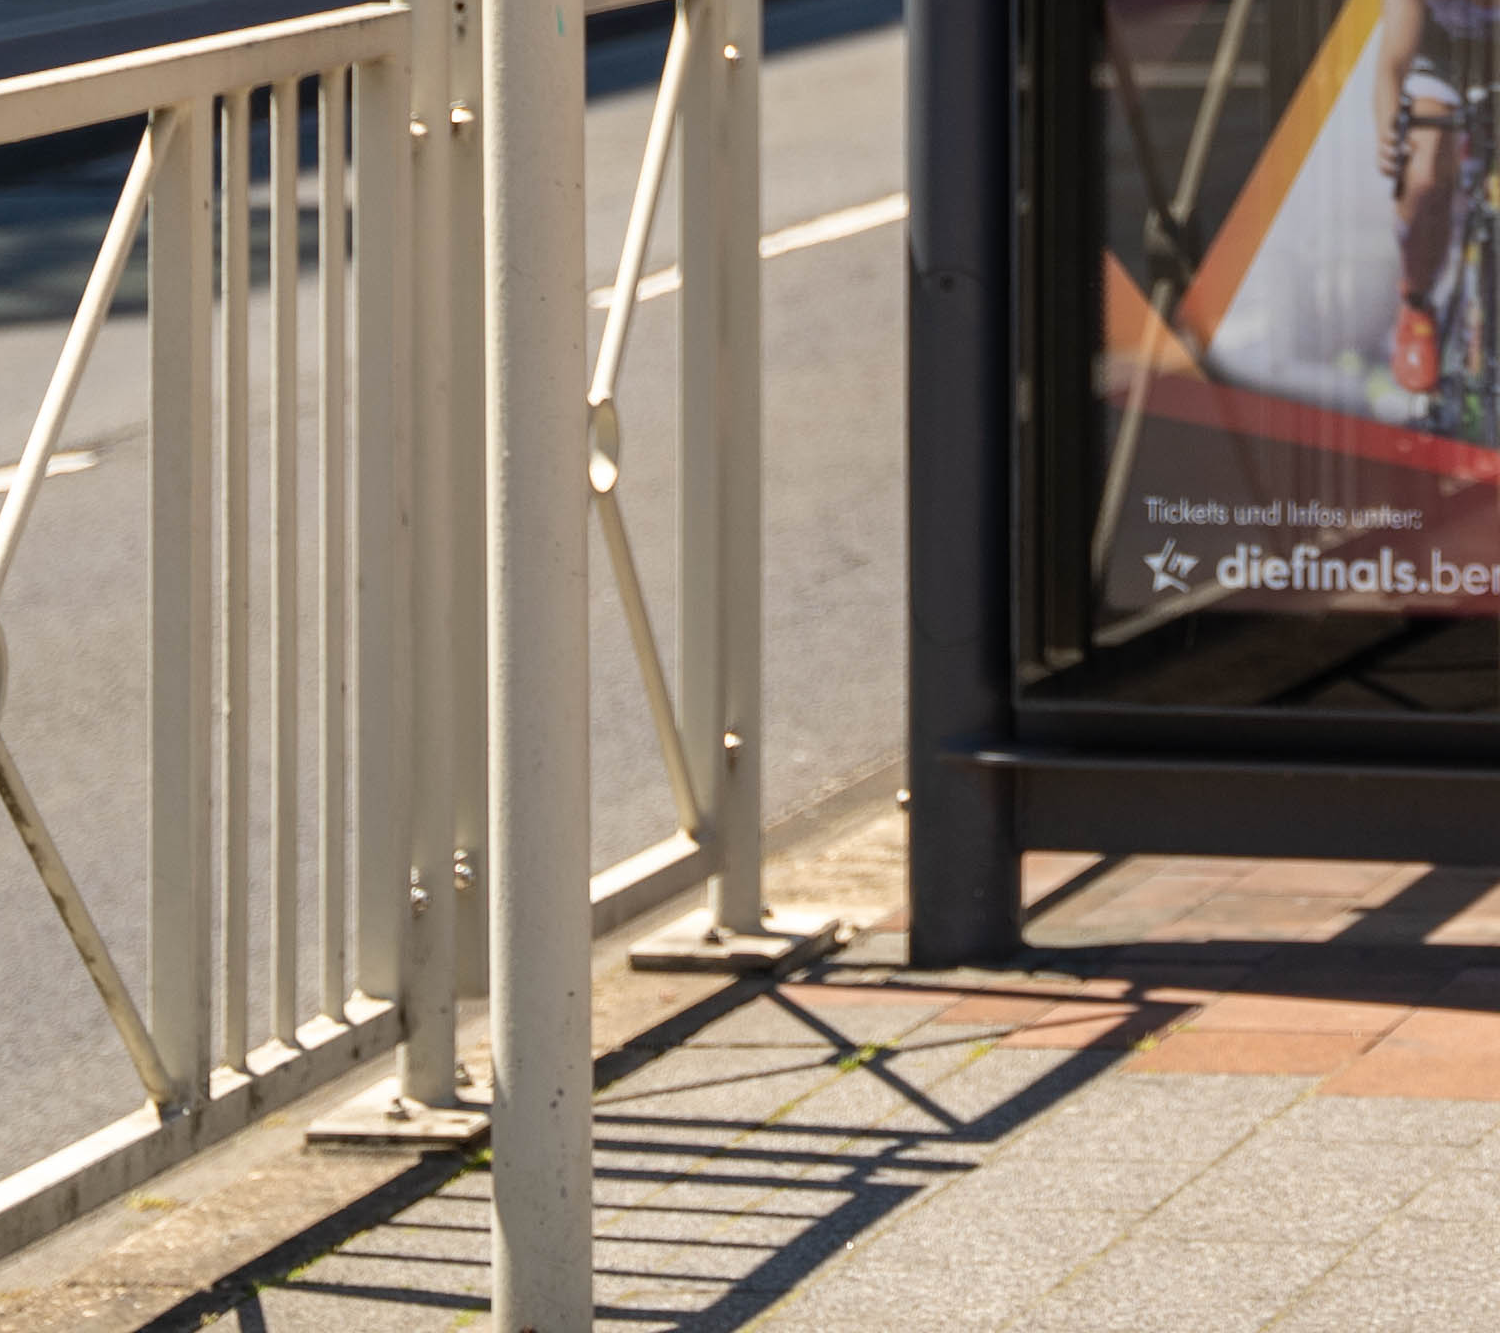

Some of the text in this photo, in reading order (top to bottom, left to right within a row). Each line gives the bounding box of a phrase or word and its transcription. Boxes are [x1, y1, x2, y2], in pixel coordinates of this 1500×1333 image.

[1144, 496, 1423, 531] Tickets und Infos unter:
